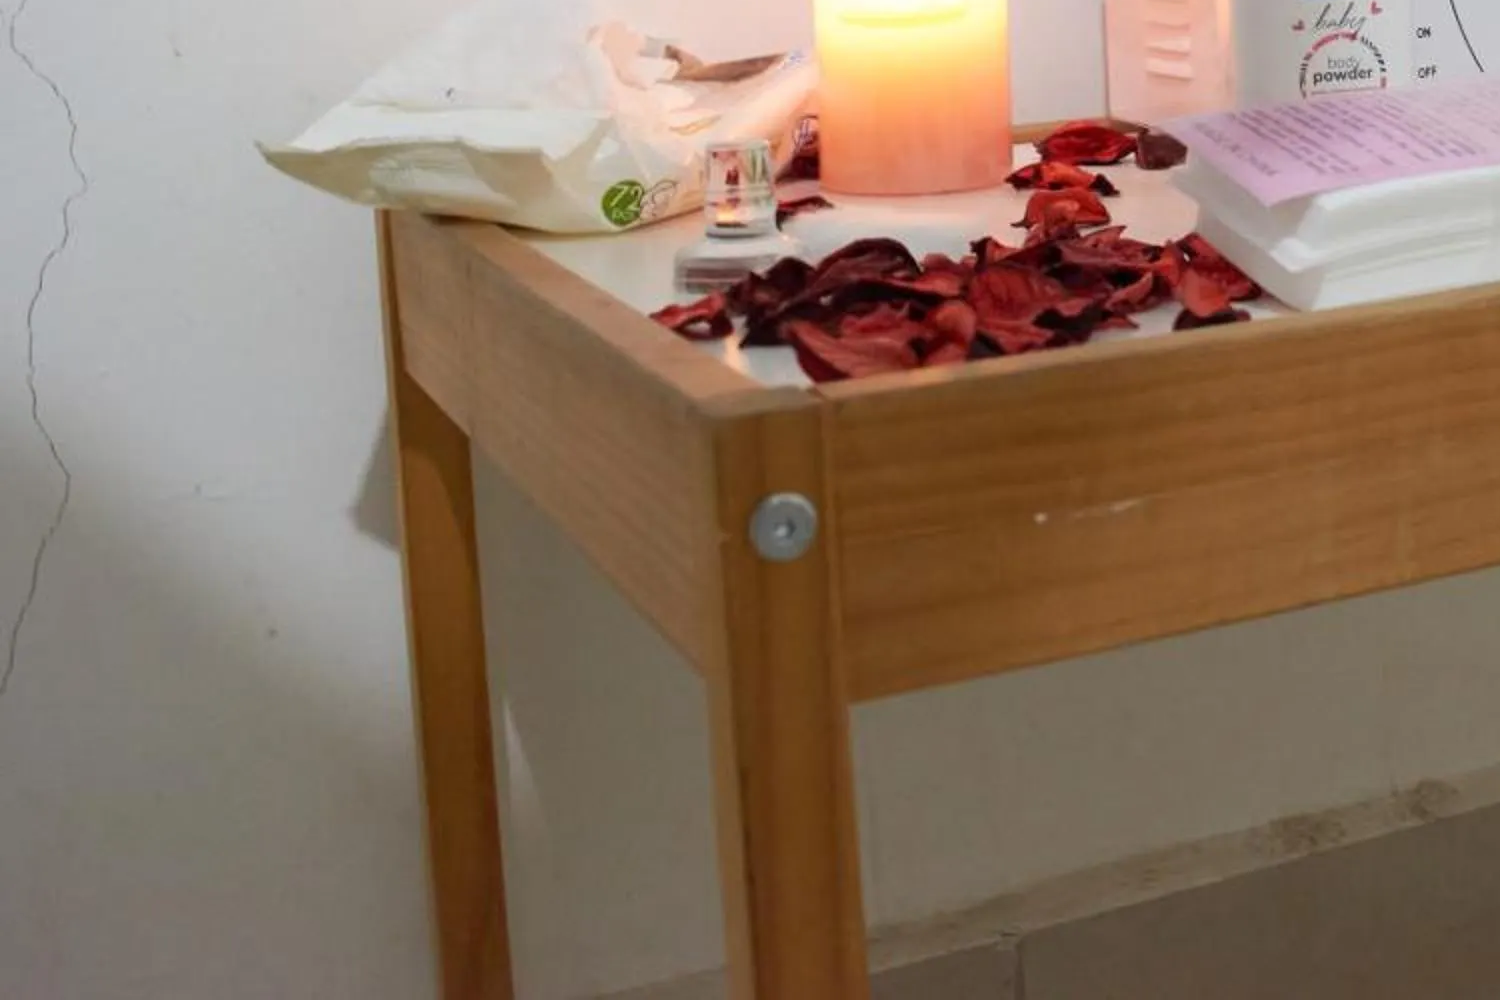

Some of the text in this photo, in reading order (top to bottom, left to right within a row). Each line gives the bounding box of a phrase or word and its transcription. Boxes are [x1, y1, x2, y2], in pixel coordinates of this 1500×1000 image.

[1314, 1, 1366, 39] baby
[1416, 27, 1431, 38] ON
[1327, 55, 1360, 73] body
[1418, 66, 1437, 78] OFF
[1313, 66, 1372, 87] powder
[611, 185, 642, 212] 72
